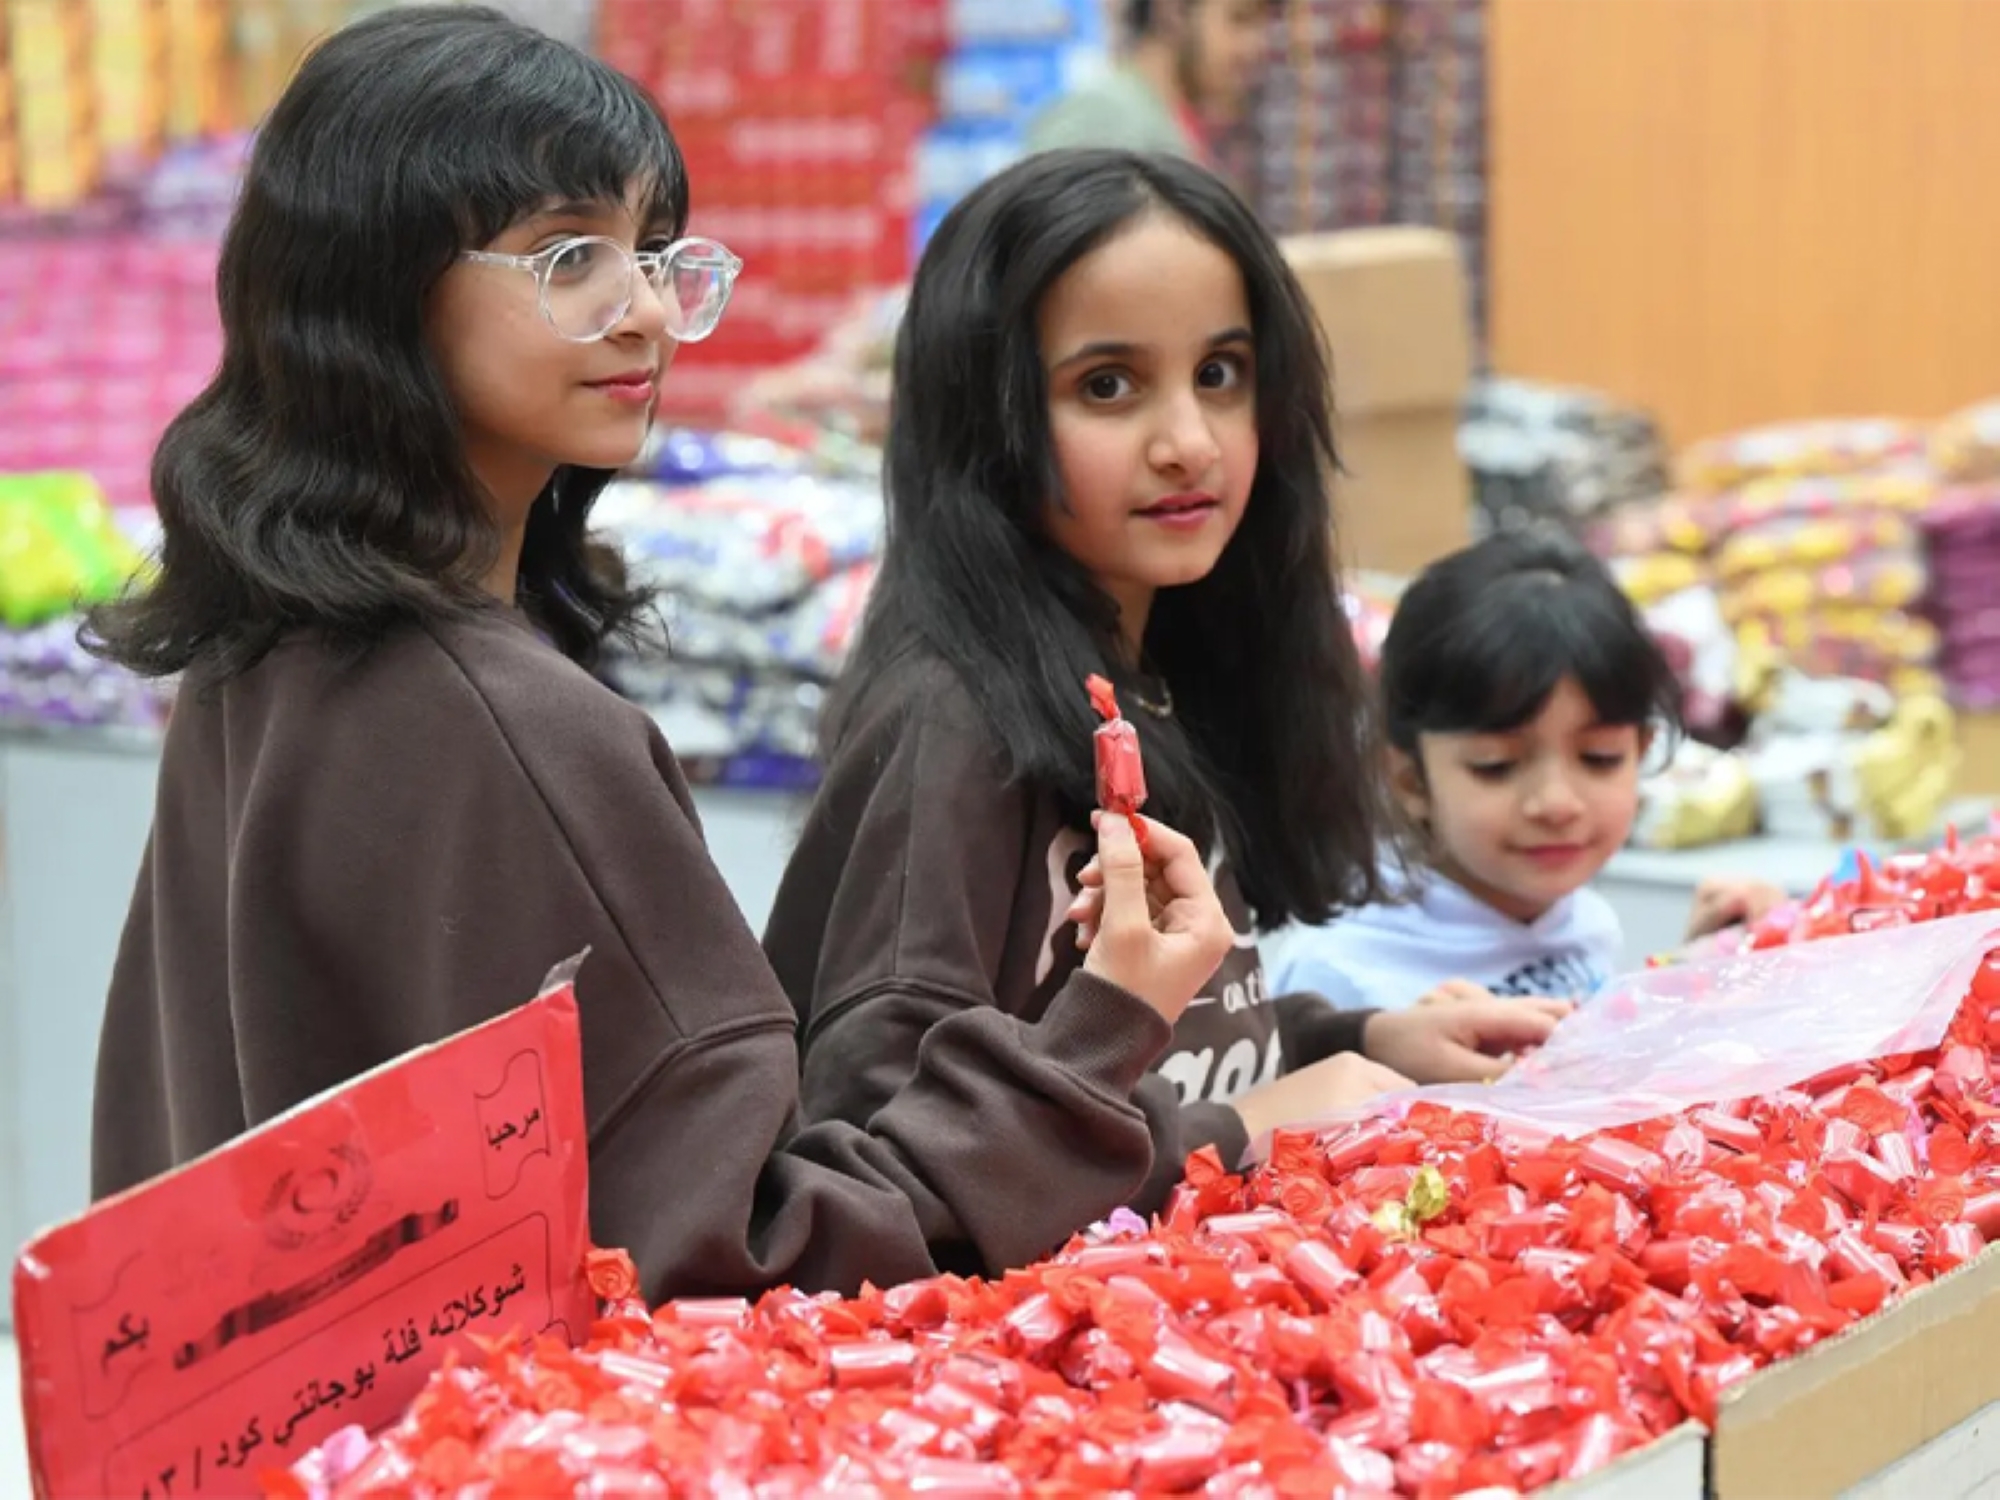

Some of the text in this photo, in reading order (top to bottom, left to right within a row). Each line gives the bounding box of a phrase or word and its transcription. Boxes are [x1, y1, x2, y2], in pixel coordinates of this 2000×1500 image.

[100, 1106, 541, 1377] مرحبا بكم
[216, 1413, 263, 1468] كود
